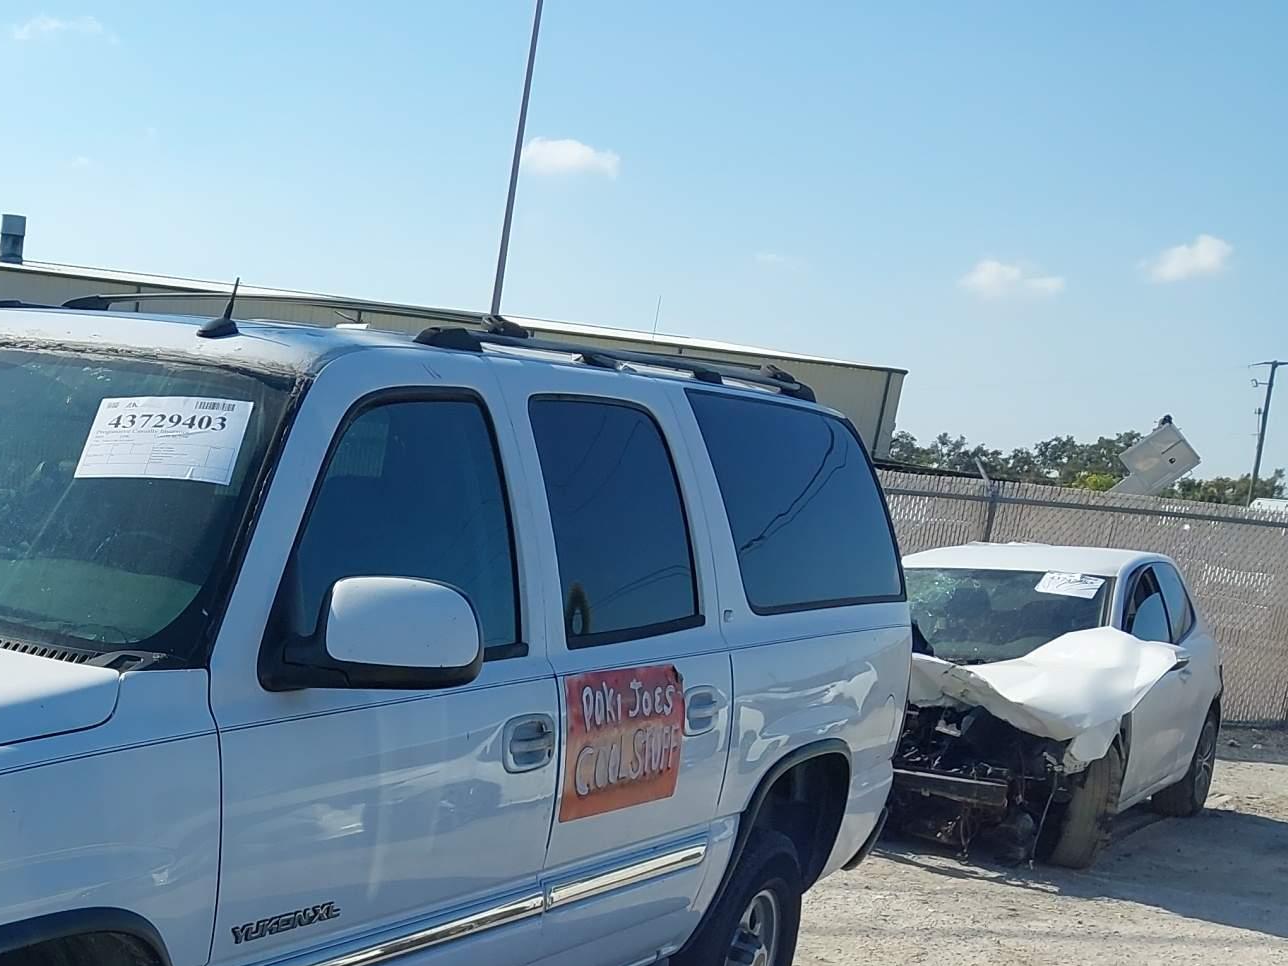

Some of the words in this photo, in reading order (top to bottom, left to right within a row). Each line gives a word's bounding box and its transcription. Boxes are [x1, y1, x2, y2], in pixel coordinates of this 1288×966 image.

[106, 413, 228, 432] 43729403
[574, 735, 627, 796] COOL
[630, 727, 681, 780] STUFF
